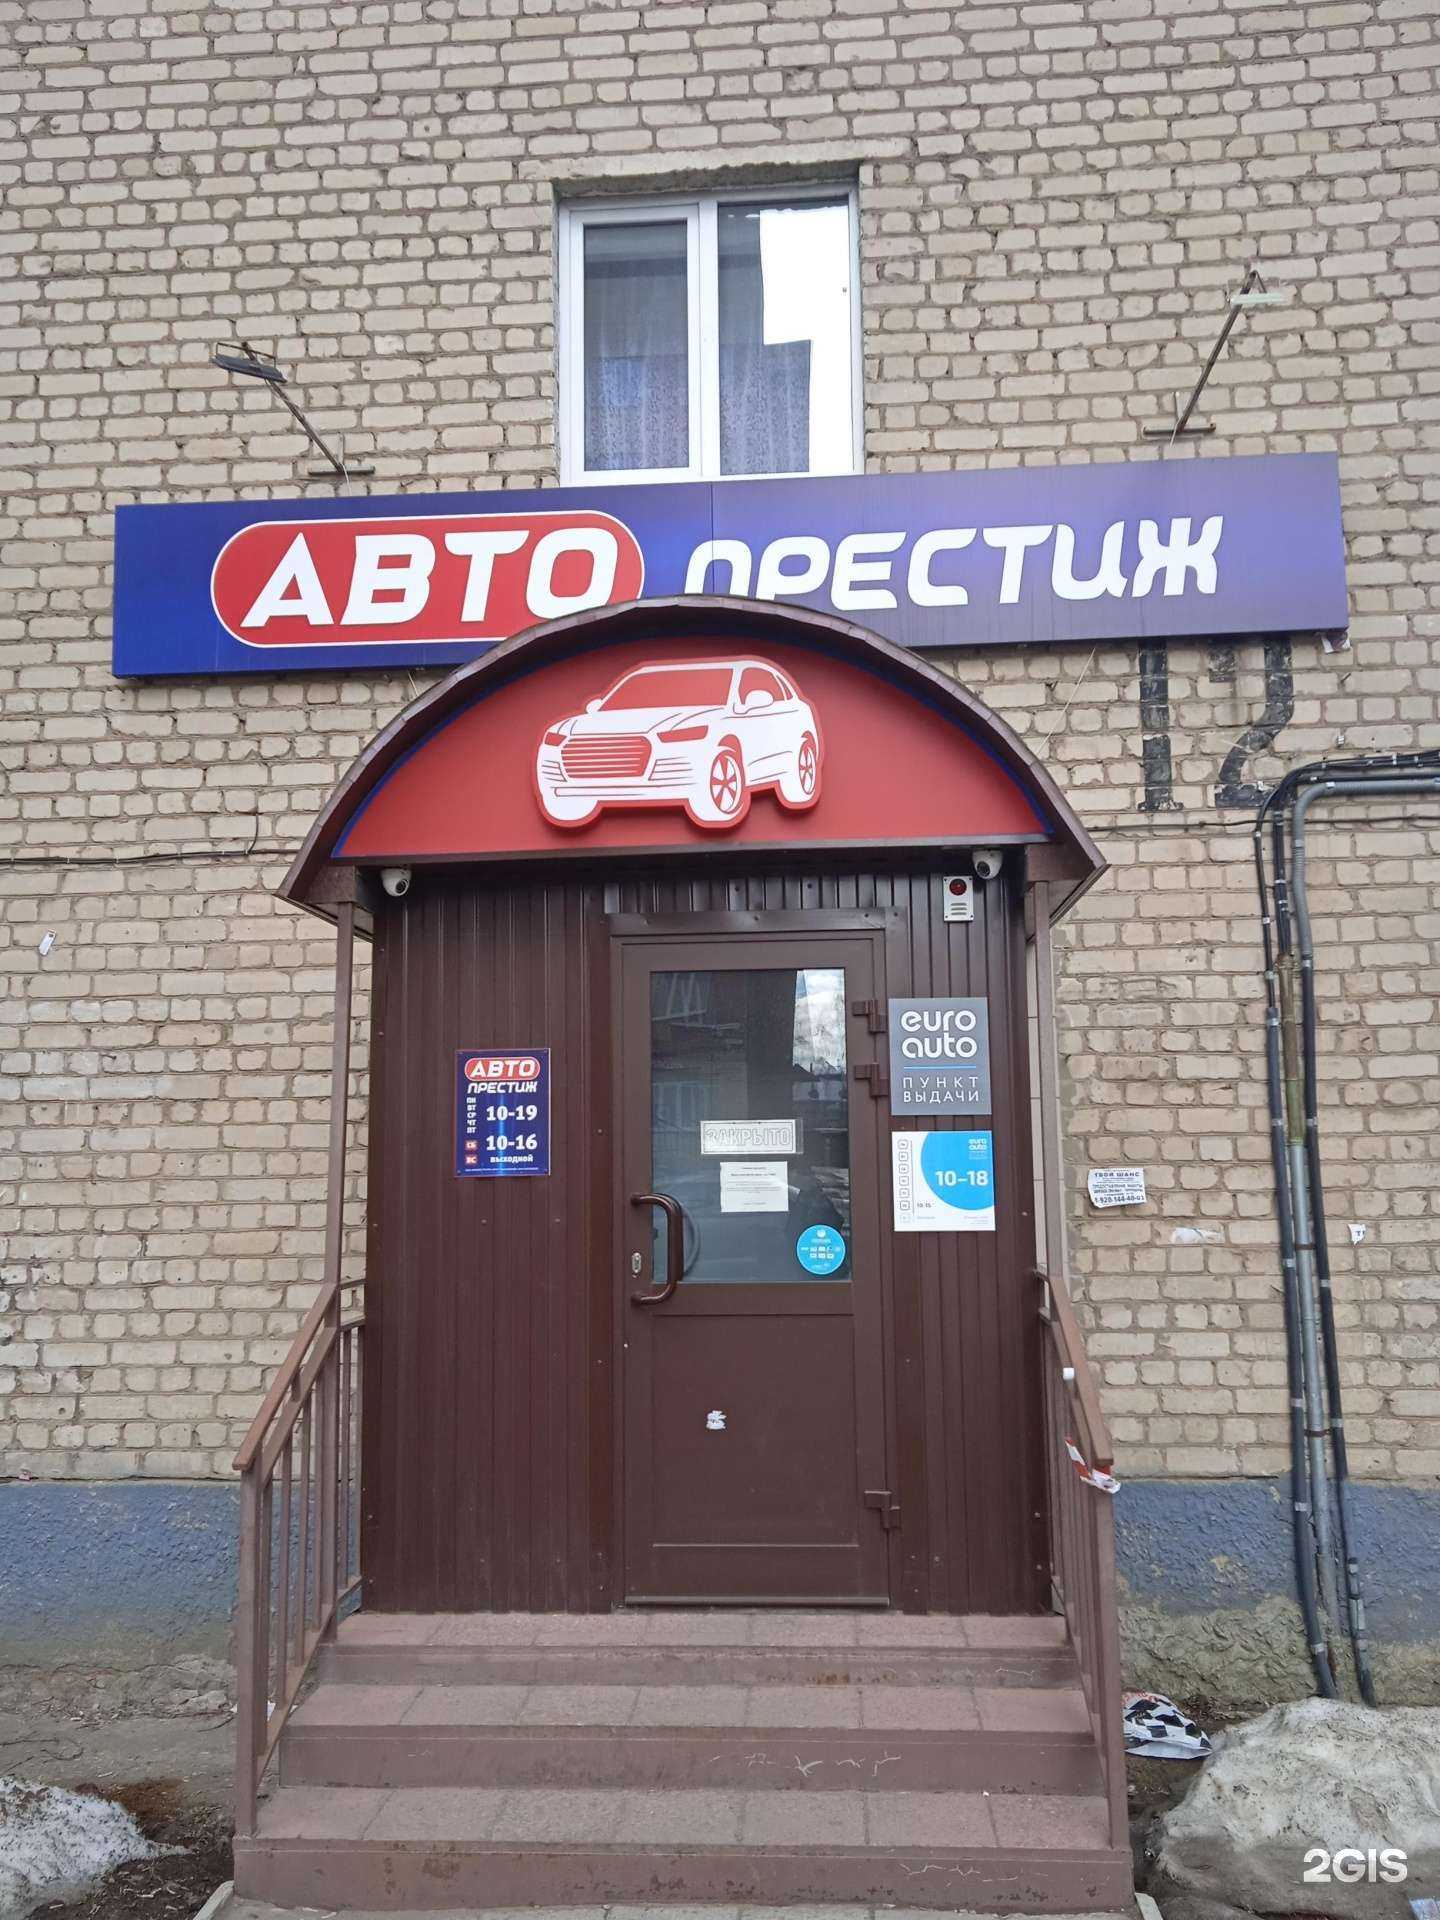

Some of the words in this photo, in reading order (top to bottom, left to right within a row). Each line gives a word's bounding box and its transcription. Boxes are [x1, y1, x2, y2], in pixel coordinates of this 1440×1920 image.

[239, 527, 618, 628] АВТО
[683, 515, 1223, 611] ПРЕСТИЖ
[901, 1010, 977, 1032] euro
[902, 1032, 978, 1058] auto
[470, 1060, 536, 1077] АВТО
[467, 1081, 538, 1094] ПРЕСТИЖ
[903, 1076, 979, 1088] ПУНКТ
[903, 1090, 979, 1104] ВЫДАЧИ
[486, 1105, 538, 1121] 10-19
[486, 1133, 538, 1151] 10-16
[705, 1127, 792, 1147] ЗАКРЫТО
